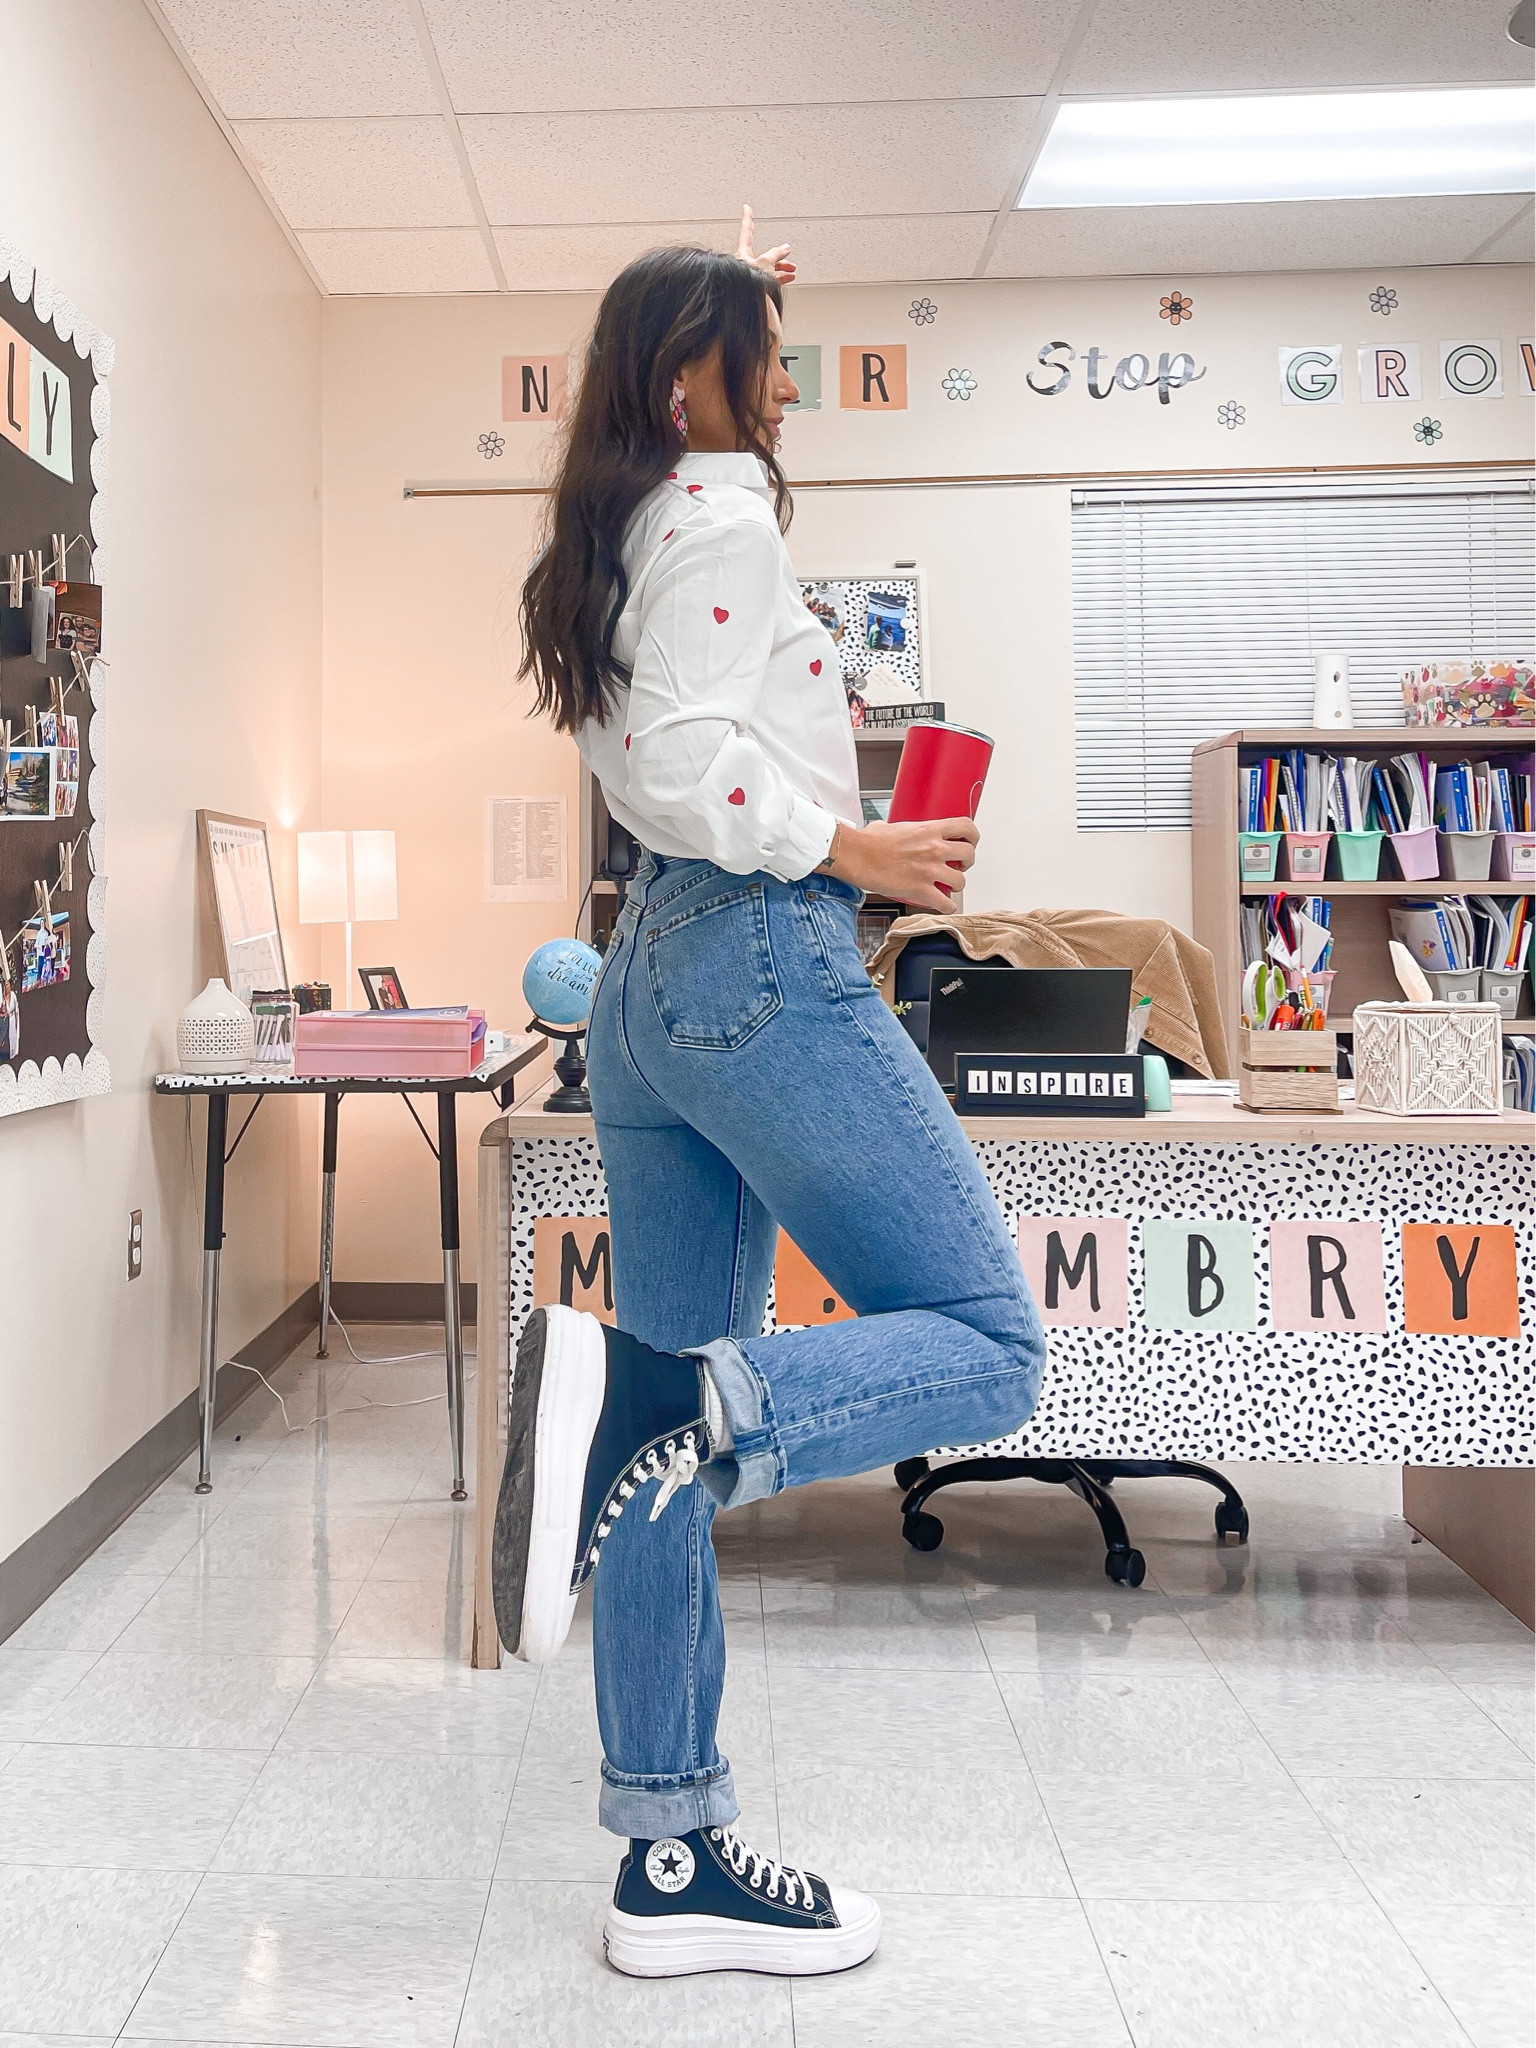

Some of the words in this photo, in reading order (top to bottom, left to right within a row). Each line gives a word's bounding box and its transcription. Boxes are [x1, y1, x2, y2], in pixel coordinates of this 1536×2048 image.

[1026, 341, 1207, 404] Stop
[865, 710, 874, 721] THE
[876, 709, 895, 720] FUTURE
[896, 708, 902, 718] OF
[904, 707, 913, 718] THE
[914, 705, 934, 717] WORLD
[547, 966, 593, 996] dream
[976, 1075, 1127, 1094] INSPIRE
[1045, 1230, 1480, 1320] MBRY
[652, 1842, 690, 1860] CONVERSE
[653, 1874, 665, 1887] ALL
[667, 1876, 686, 1888] STAR
